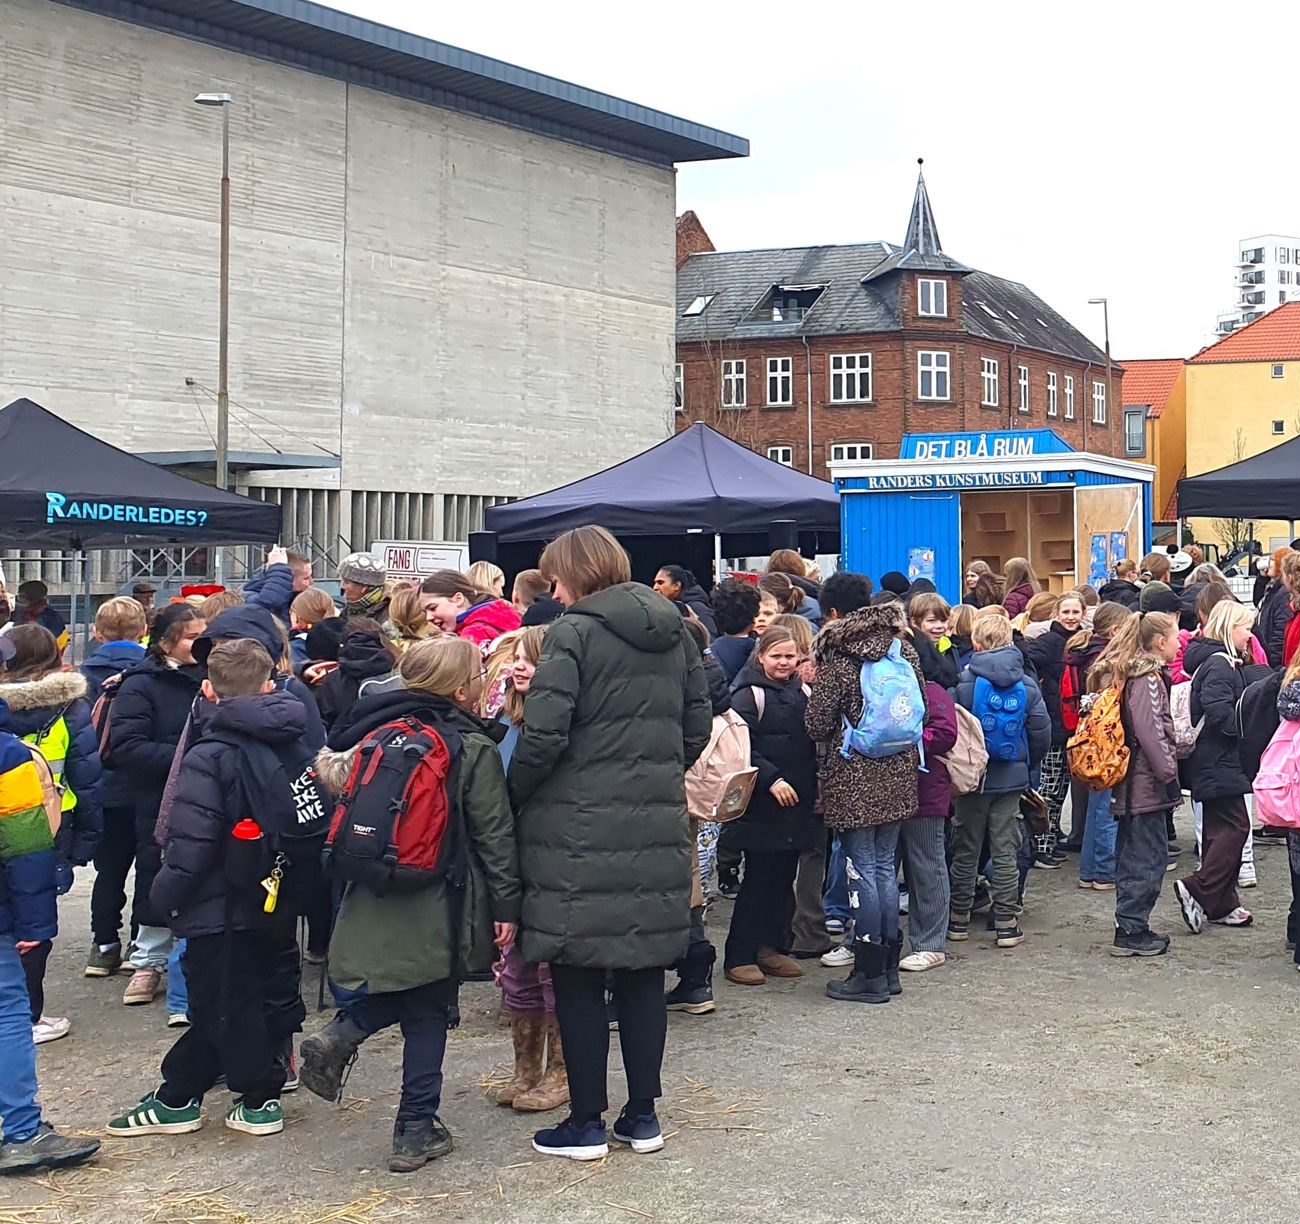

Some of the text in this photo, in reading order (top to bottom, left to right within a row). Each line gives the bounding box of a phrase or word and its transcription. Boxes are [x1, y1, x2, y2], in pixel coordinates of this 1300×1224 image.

[915, 434, 1034, 459] DET BLÅ RUM
[868, 472, 1042, 489] RANDERS KUNSTMUSEUM
[45, 492, 208, 526] RANDERLEDES?
[387, 549, 411, 569] FANG
